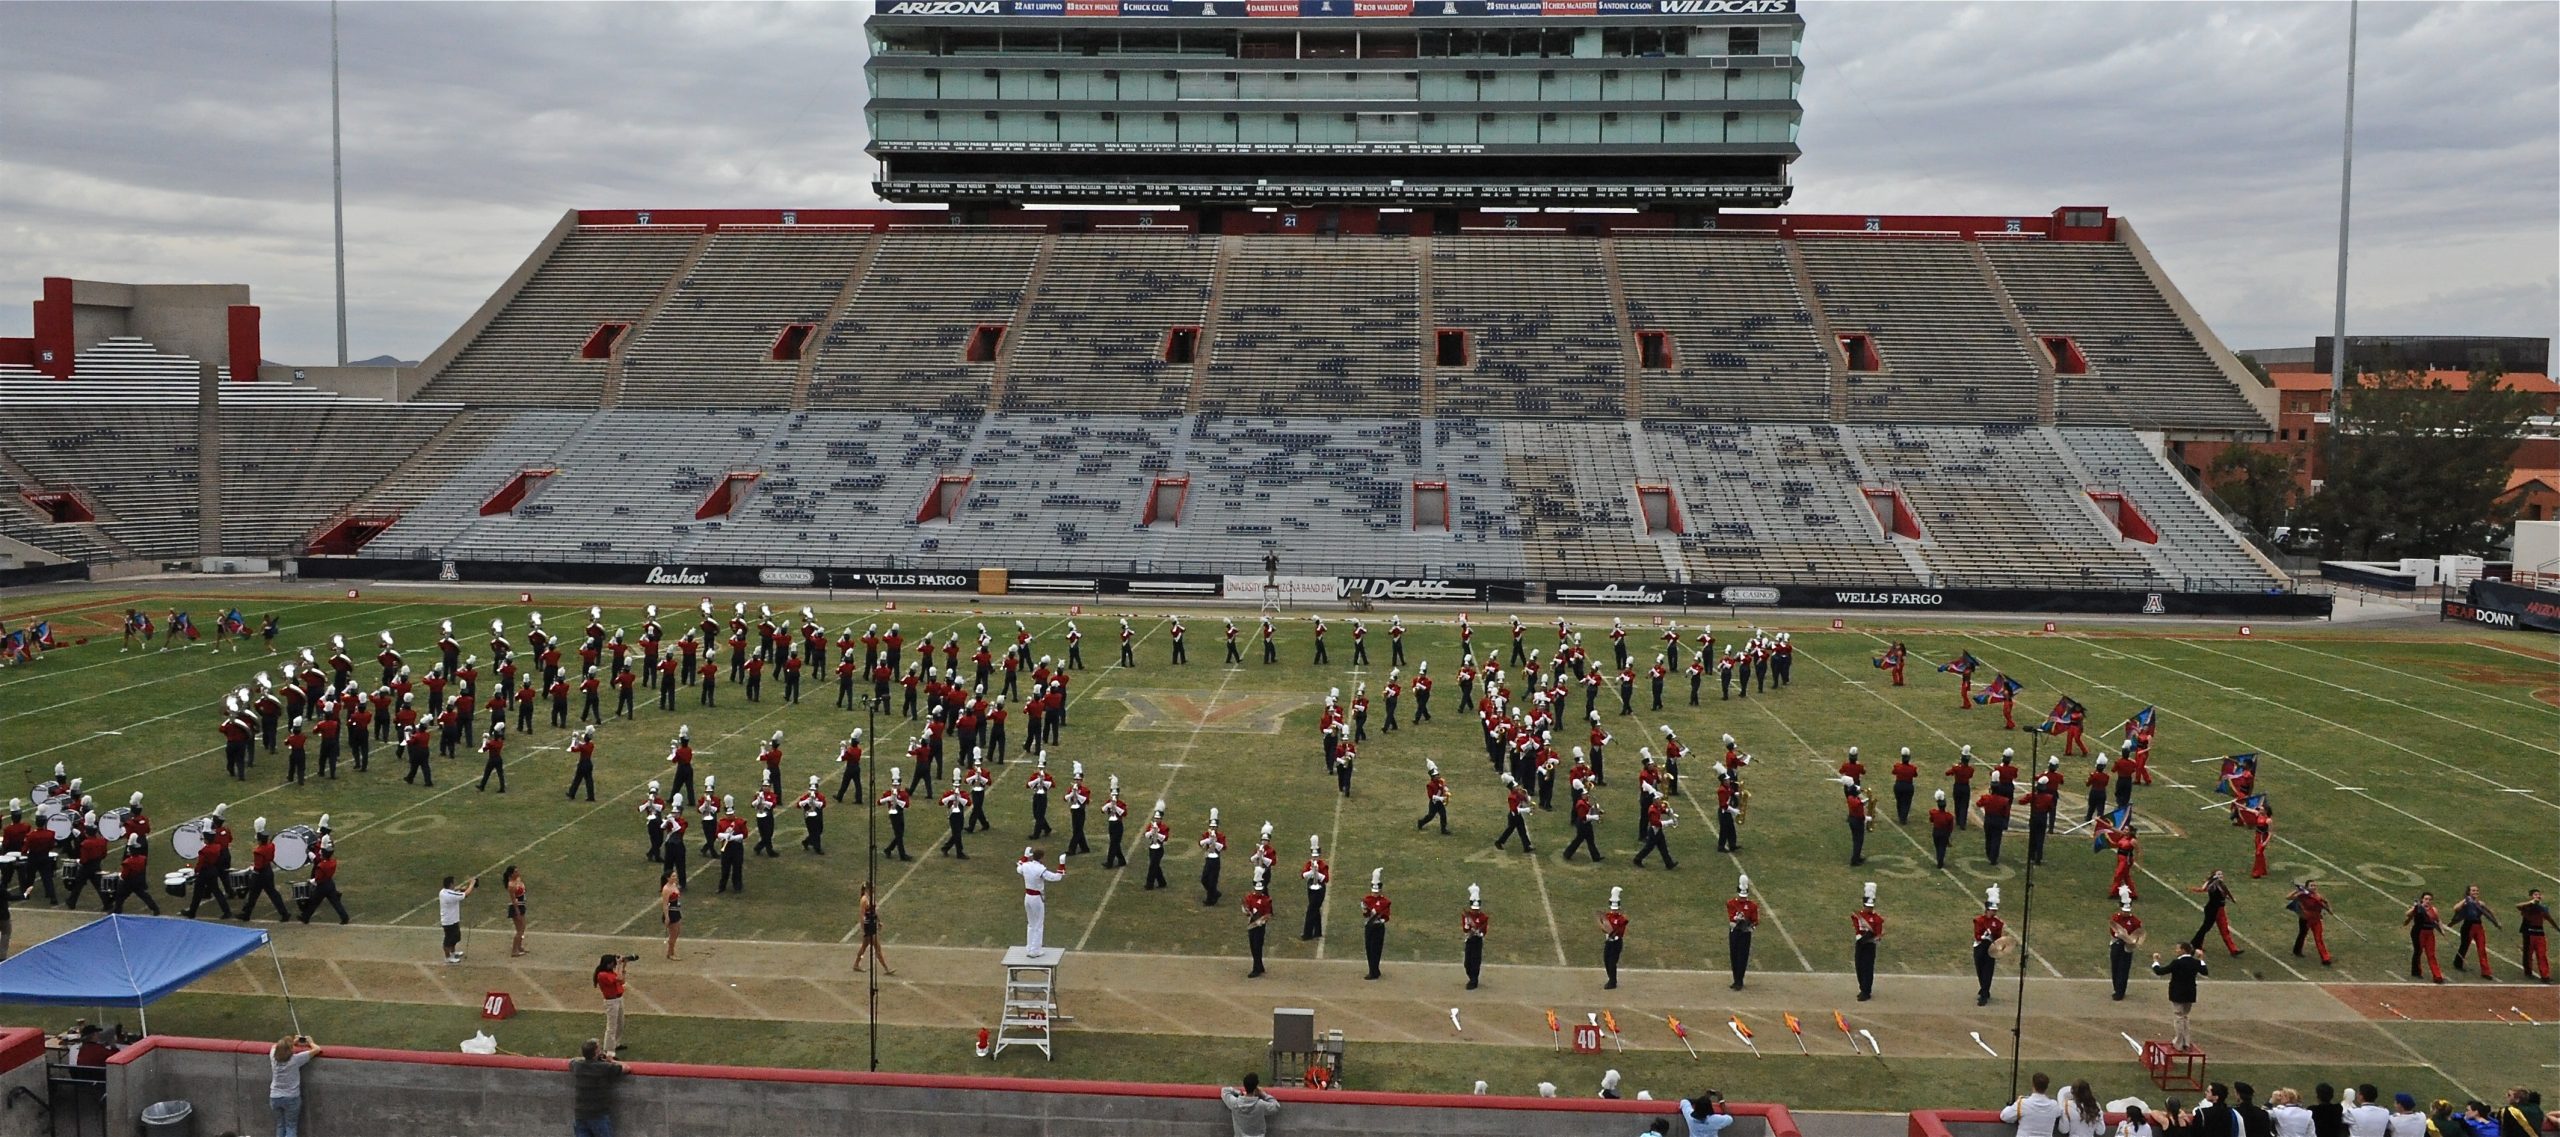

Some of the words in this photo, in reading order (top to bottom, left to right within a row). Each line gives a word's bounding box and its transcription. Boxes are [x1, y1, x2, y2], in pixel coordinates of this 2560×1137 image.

[888, 1, 1000, 14] ARIZONA
[1015, 2, 1022, 10] 22
[1129, 3, 1150, 11] CHUCK
[1152, 3, 1169, 11] CECIL
[1246, 4, 1251, 12] 4
[1252, 4, 1279, 12] DARRYLL
[1280, 4, 1299, 12] LEWIS
[1363, 3, 1376, 11] ROB
[1377, 3, 1408, 11] WALDROP
[1660, 1, 1788, 13] WILDCATS
[639, 216, 649, 225] 17
[783, 216, 794, 225] 18
[951, 216, 961, 225] 19
[1139, 217, 1152, 225] 20
[1285, 218, 1296, 226] 21
[1505, 219, 1517, 228] 22
[1703, 220, 1715, 229] 23
[1866, 222, 1879, 231] 24
[2007, 224, 2020, 232] 25
[43, 352, 53, 361] 15
[295, 371, 305, 379] 16
[866, 574, 916, 585] WELLS
[919, 575, 967, 586] FARGO
[1226, 583, 1260, 592] UNIVERSITY
[1302, 584, 1320, 592] BAND
[1321, 584, 1335, 592] DAY
[1743, 591, 1774, 599] CASINOS
[1836, 592, 1888, 604] WELLS
[1891, 593, 1943, 605] FARGO
[484, 995, 503, 1016] 40
[1577, 1029, 1596, 1050] 40
